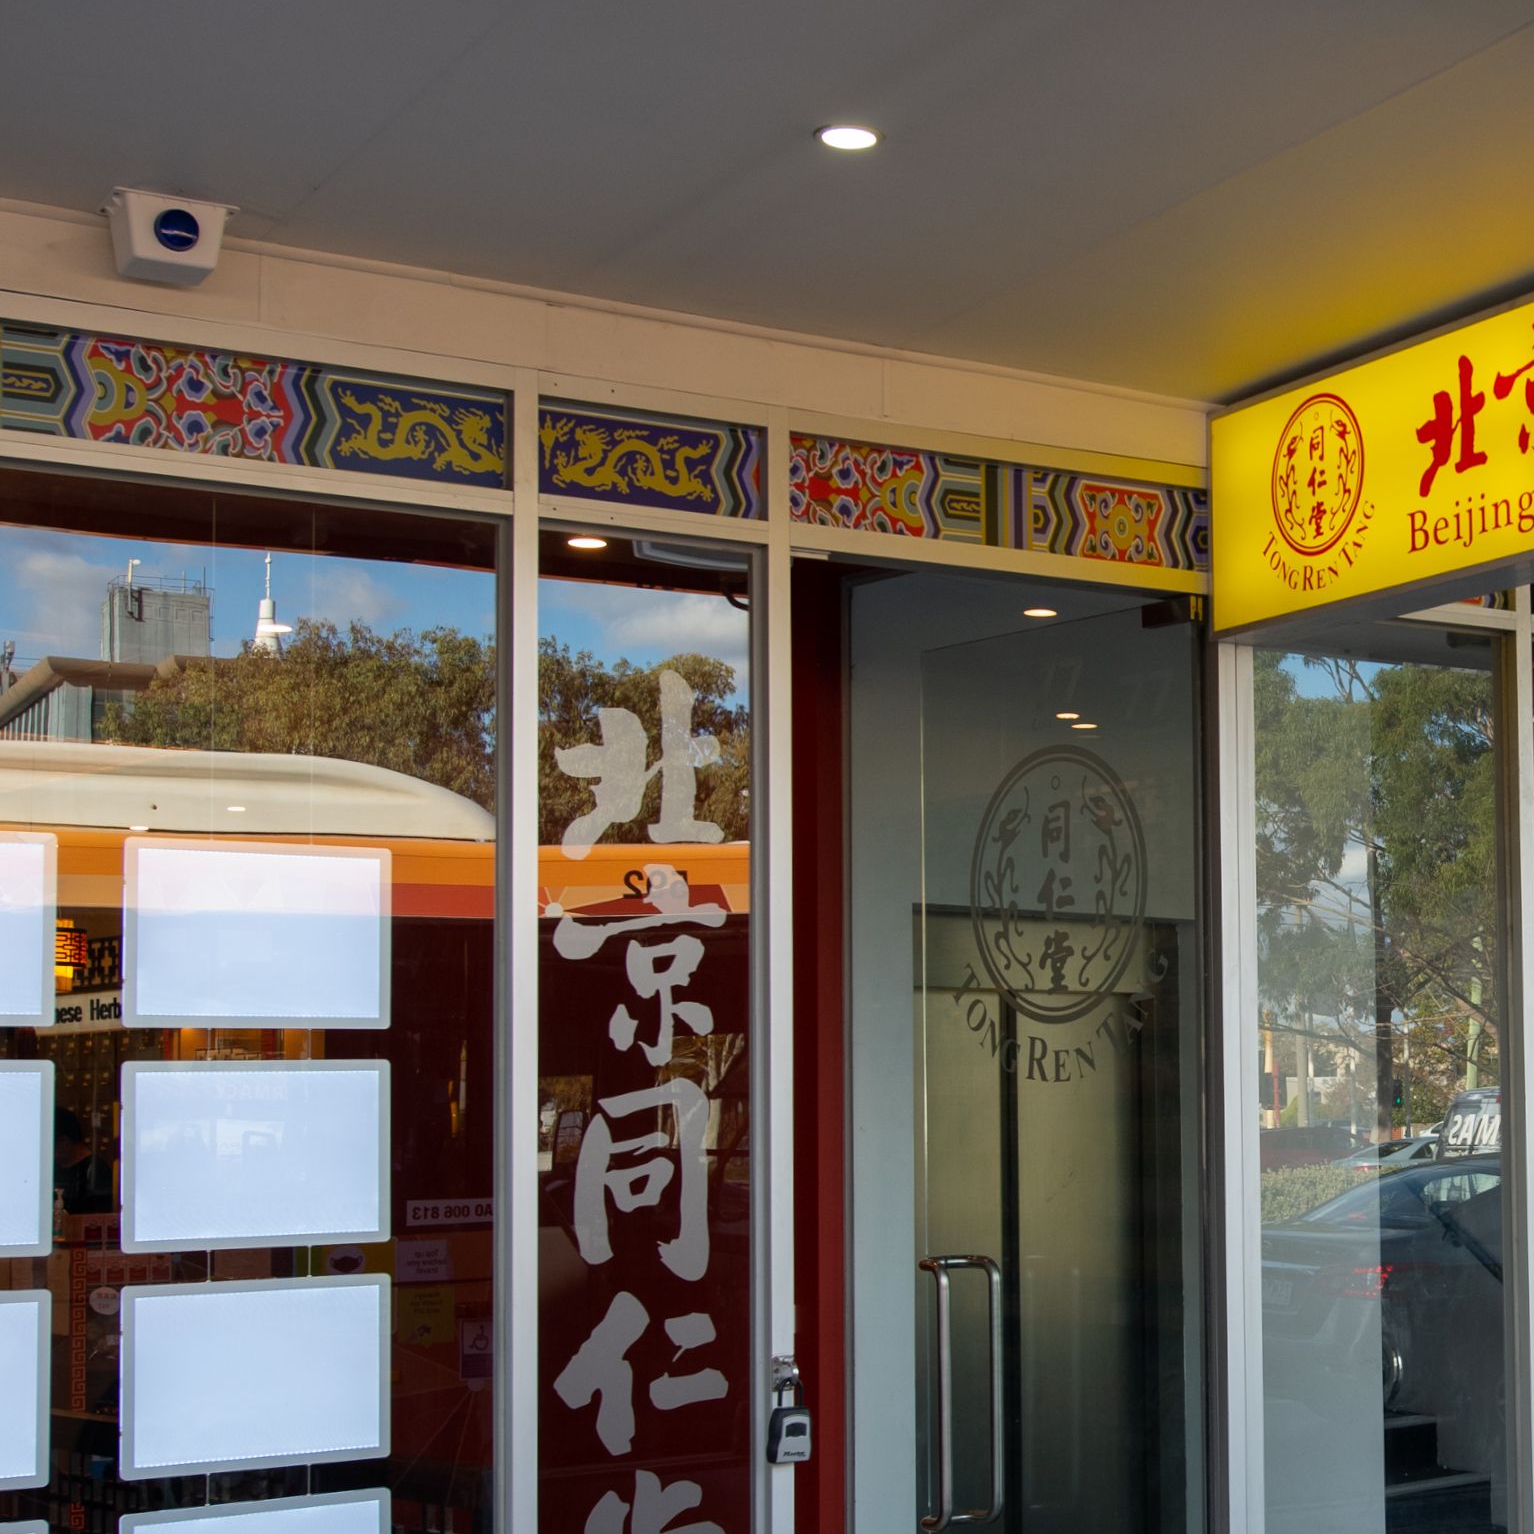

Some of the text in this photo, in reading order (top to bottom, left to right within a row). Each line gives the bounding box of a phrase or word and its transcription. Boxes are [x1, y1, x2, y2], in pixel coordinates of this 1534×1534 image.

[1307, 425, 1327, 539] 同仁堂
[1037, 800, 1075, 995] 同仁堂
